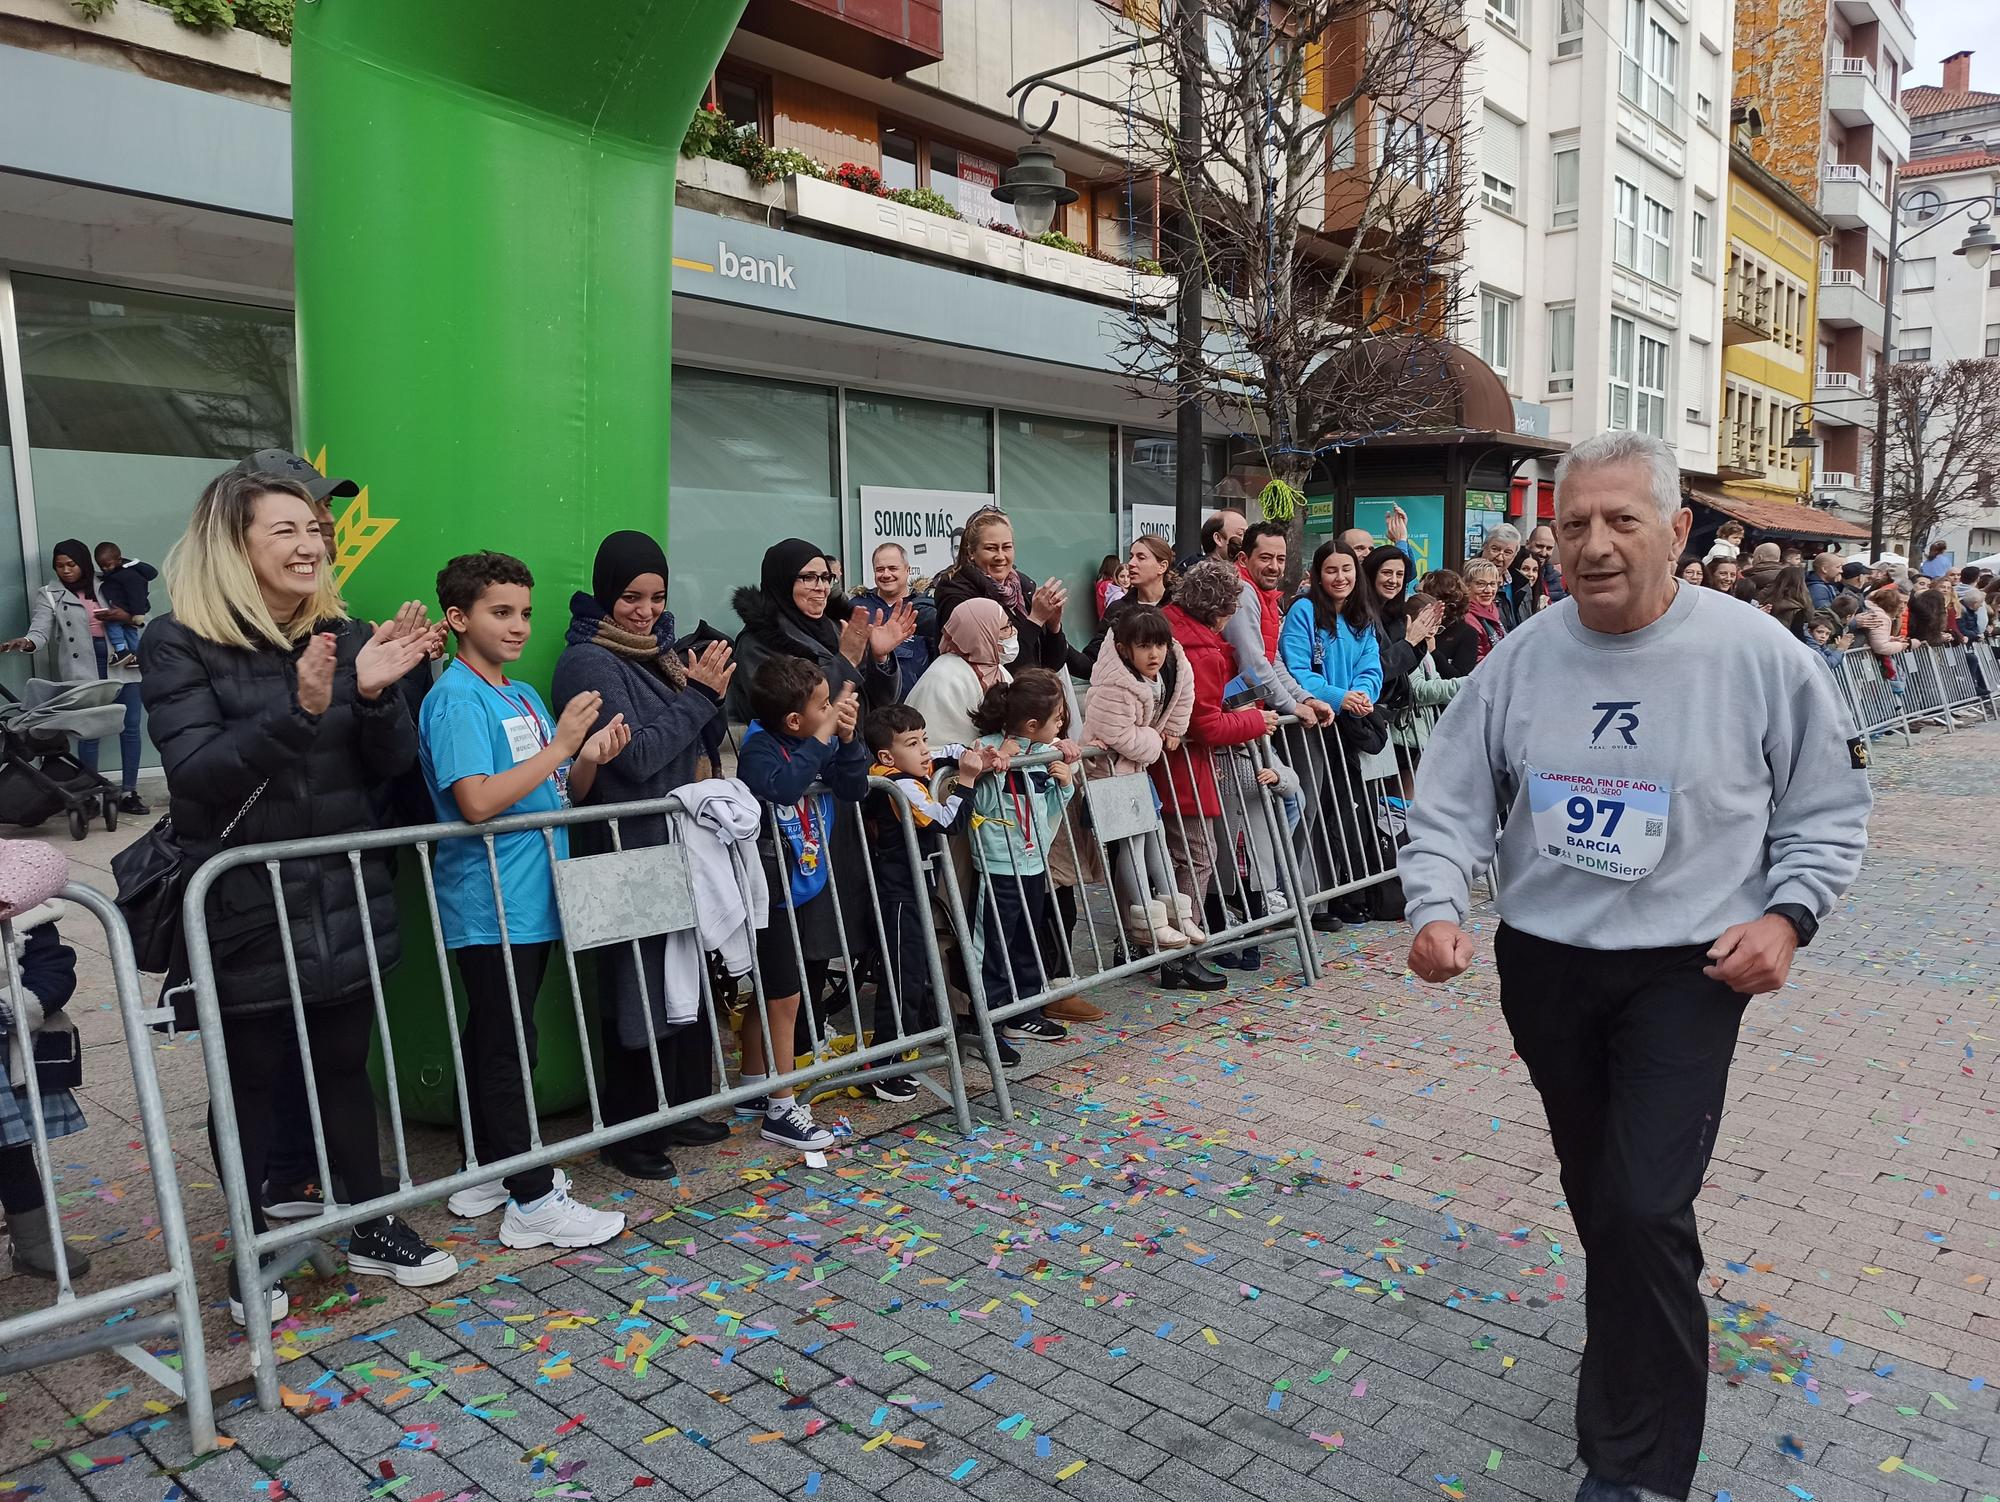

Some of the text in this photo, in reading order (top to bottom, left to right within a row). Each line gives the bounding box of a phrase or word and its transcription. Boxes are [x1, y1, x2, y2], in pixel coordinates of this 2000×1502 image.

[719, 240, 797, 290] bank
[1515, 413, 1535, 433] bank
[874, 508, 953, 538] SOMOS MÁS
[1140, 521, 1170, 543] SOMOS
[1540, 772, 1657, 792] CARRERA FIN DE AÑO
[1581, 785, 1599, 794] POLA
[1601, 786, 1622, 796] SIERO
[1566, 796, 1626, 838] 97
[1566, 836, 1622, 855] BARCIA
[1576, 854, 1648, 877] PDMSiero
